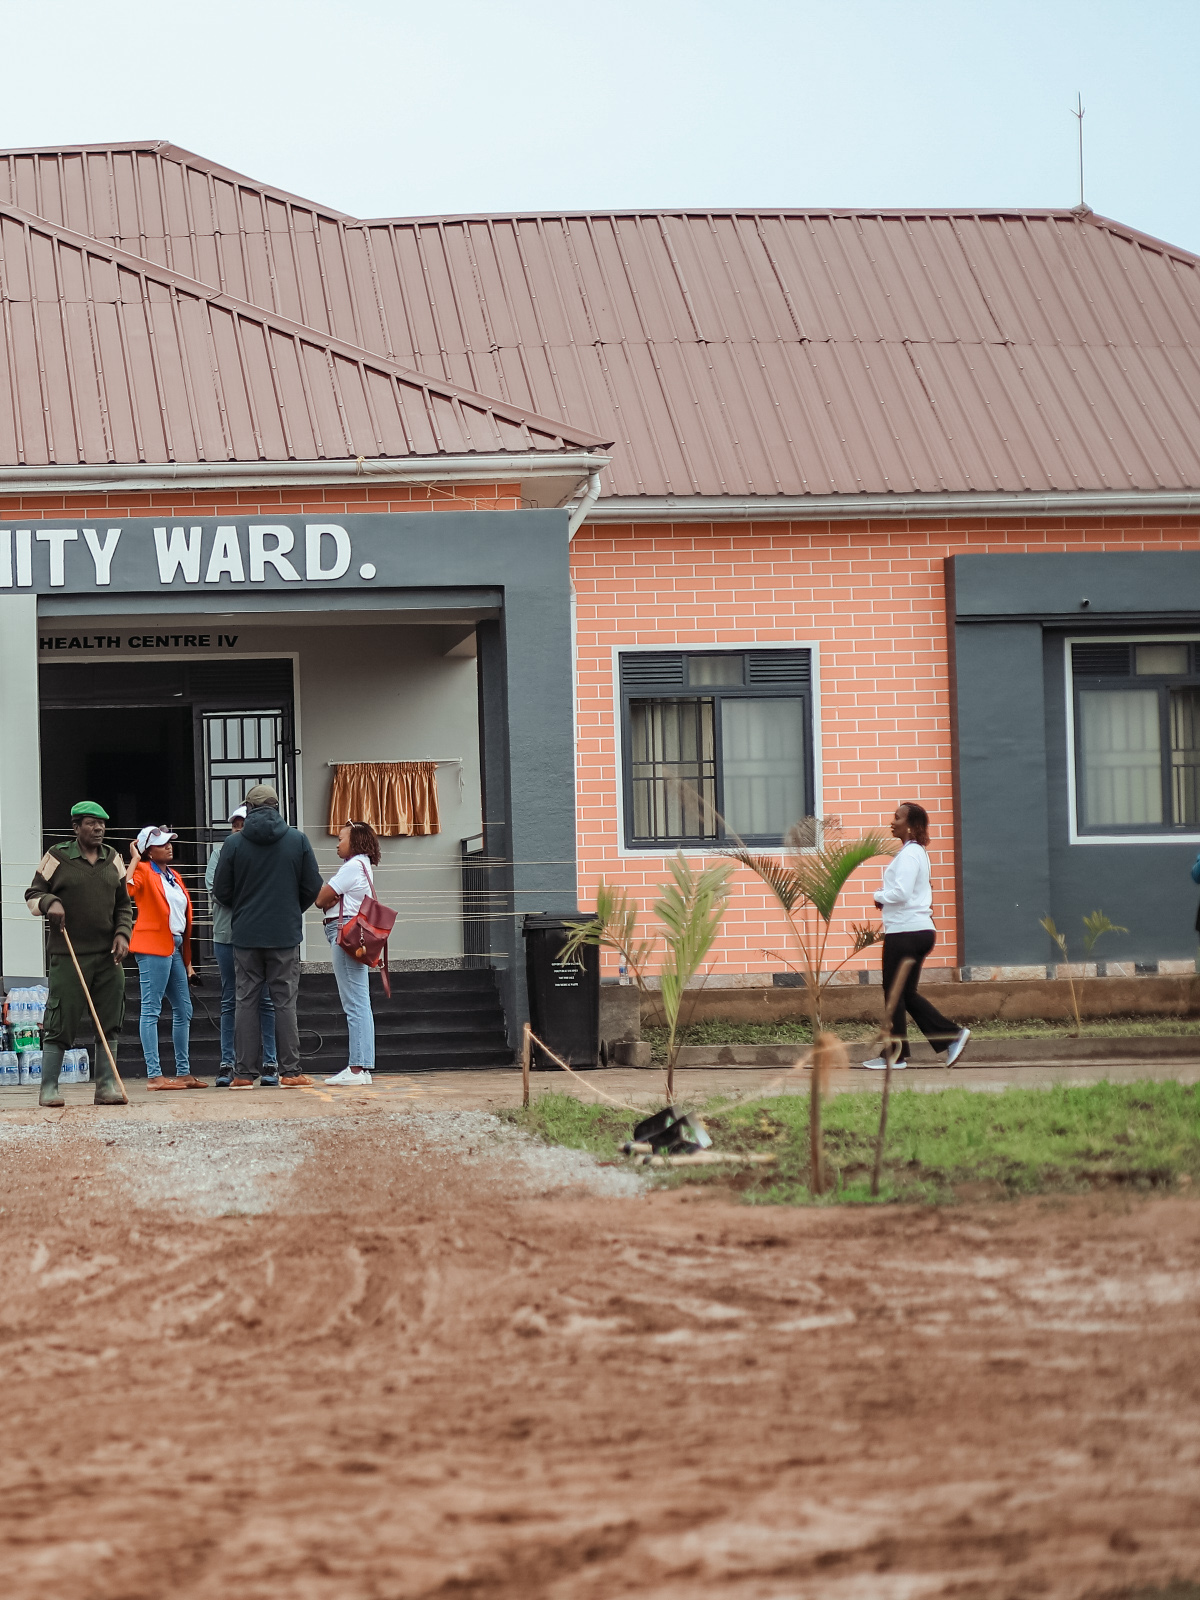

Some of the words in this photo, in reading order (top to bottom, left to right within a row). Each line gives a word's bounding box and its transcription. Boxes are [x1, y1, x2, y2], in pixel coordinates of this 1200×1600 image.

[153, 524, 377, 584] WARD.
[39, 636, 121, 650] HEALTH
[128, 634, 211, 649] CENTRE
[218, 634, 239, 647] IV
